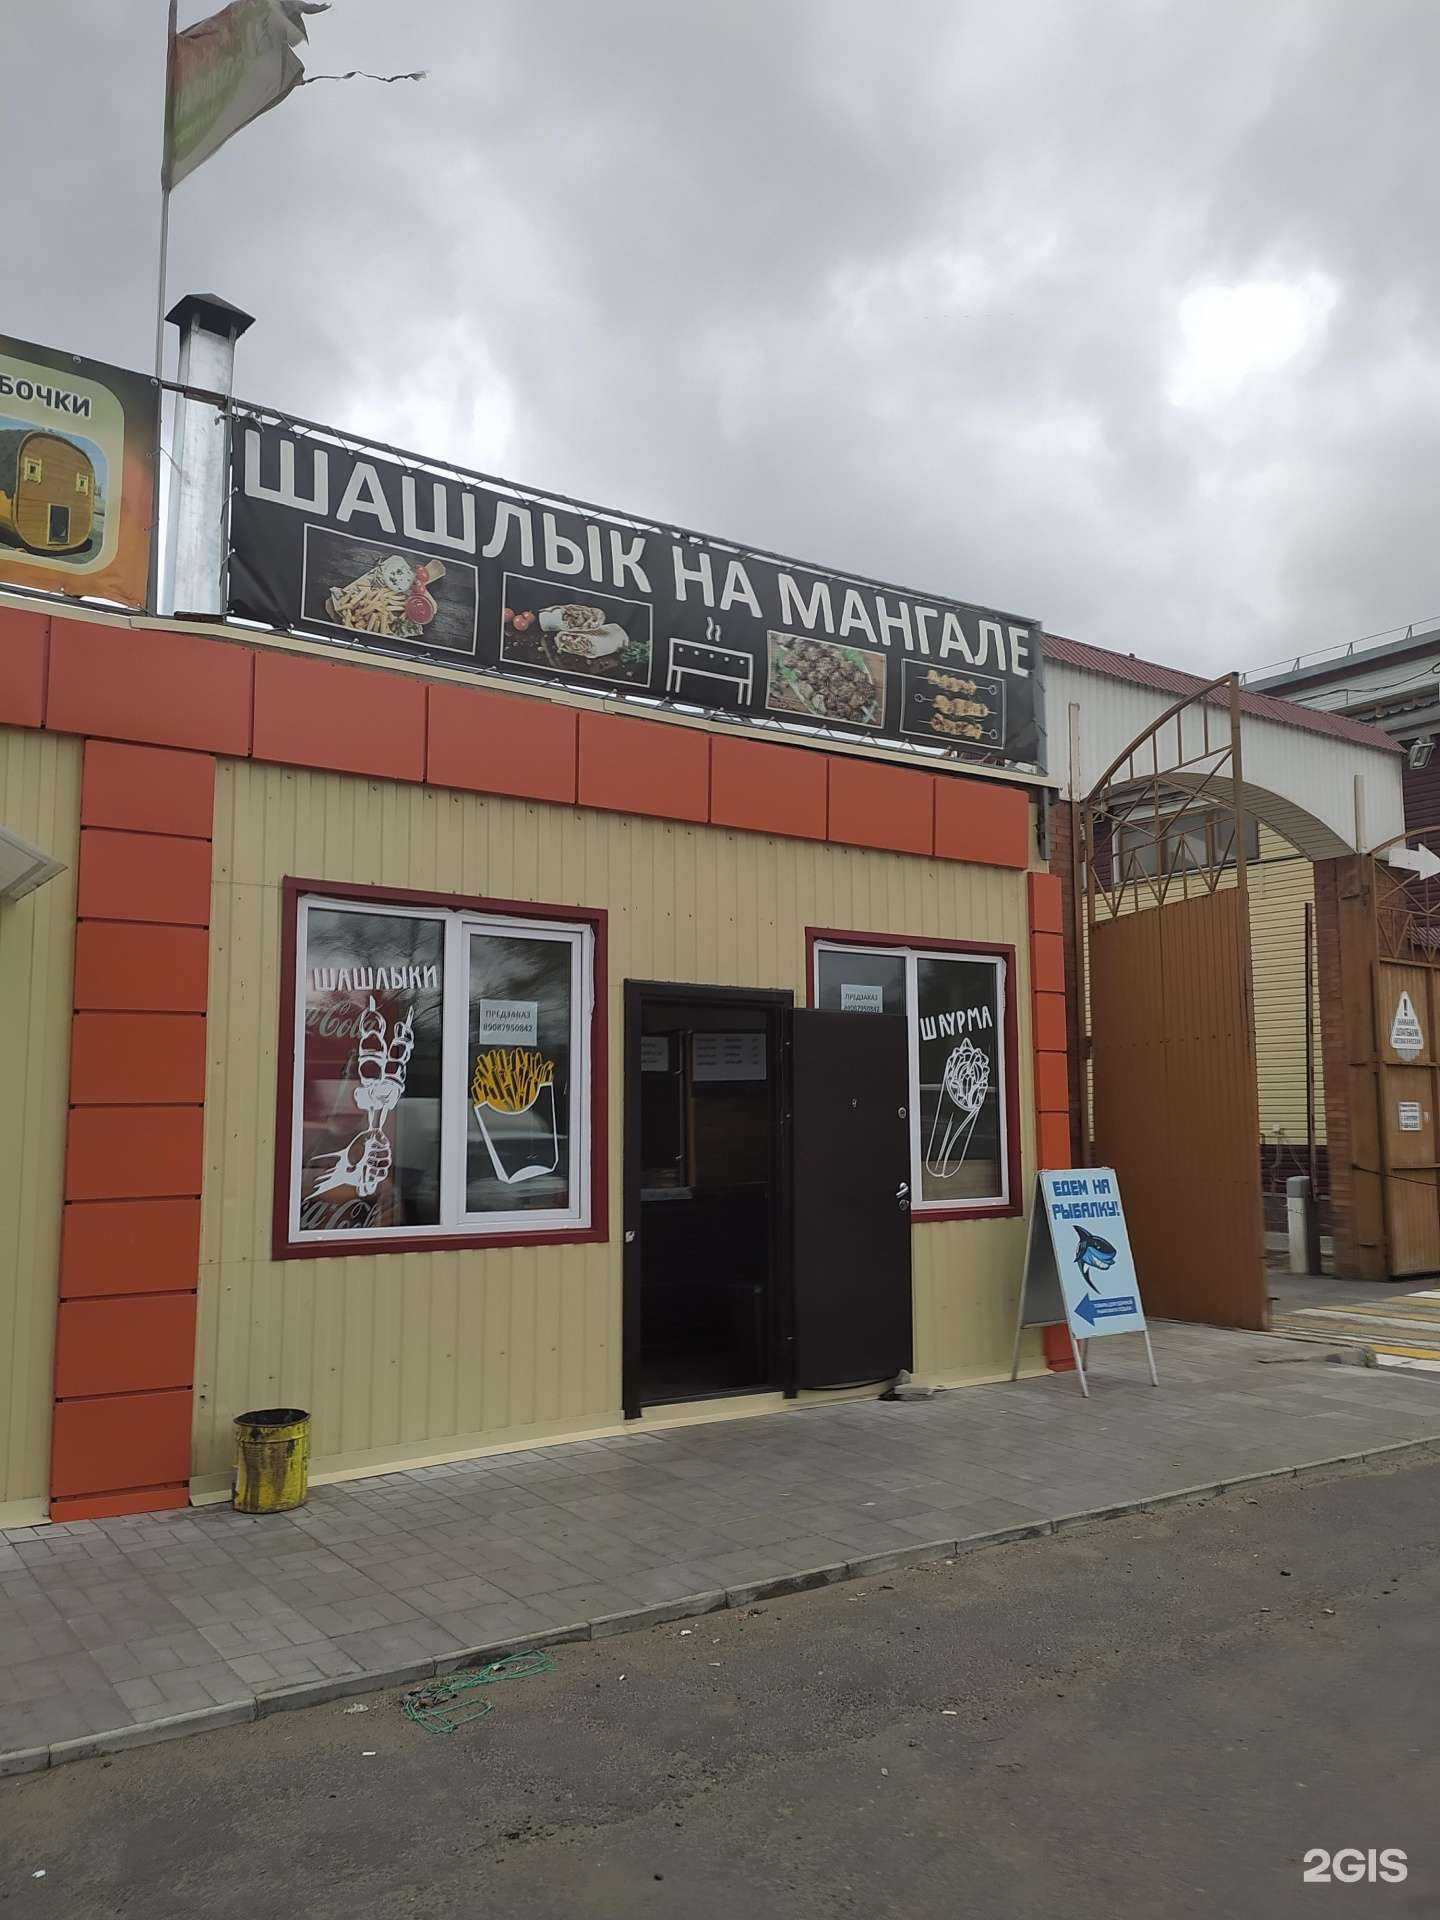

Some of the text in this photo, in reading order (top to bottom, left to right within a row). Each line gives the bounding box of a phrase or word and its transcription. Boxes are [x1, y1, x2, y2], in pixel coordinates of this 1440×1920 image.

[243, 428, 1030, 678] ШАШЛЫК НА МАНГАЛЕ
[313, 965, 438, 991] ШАШЛЫКИ
[919, 1005, 993, 1041] ШАУРМА
[1052, 1179, 1111, 1197] ЕДЕМ НА
[1052, 1201, 1121, 1220] РЫБАЛКУ!
